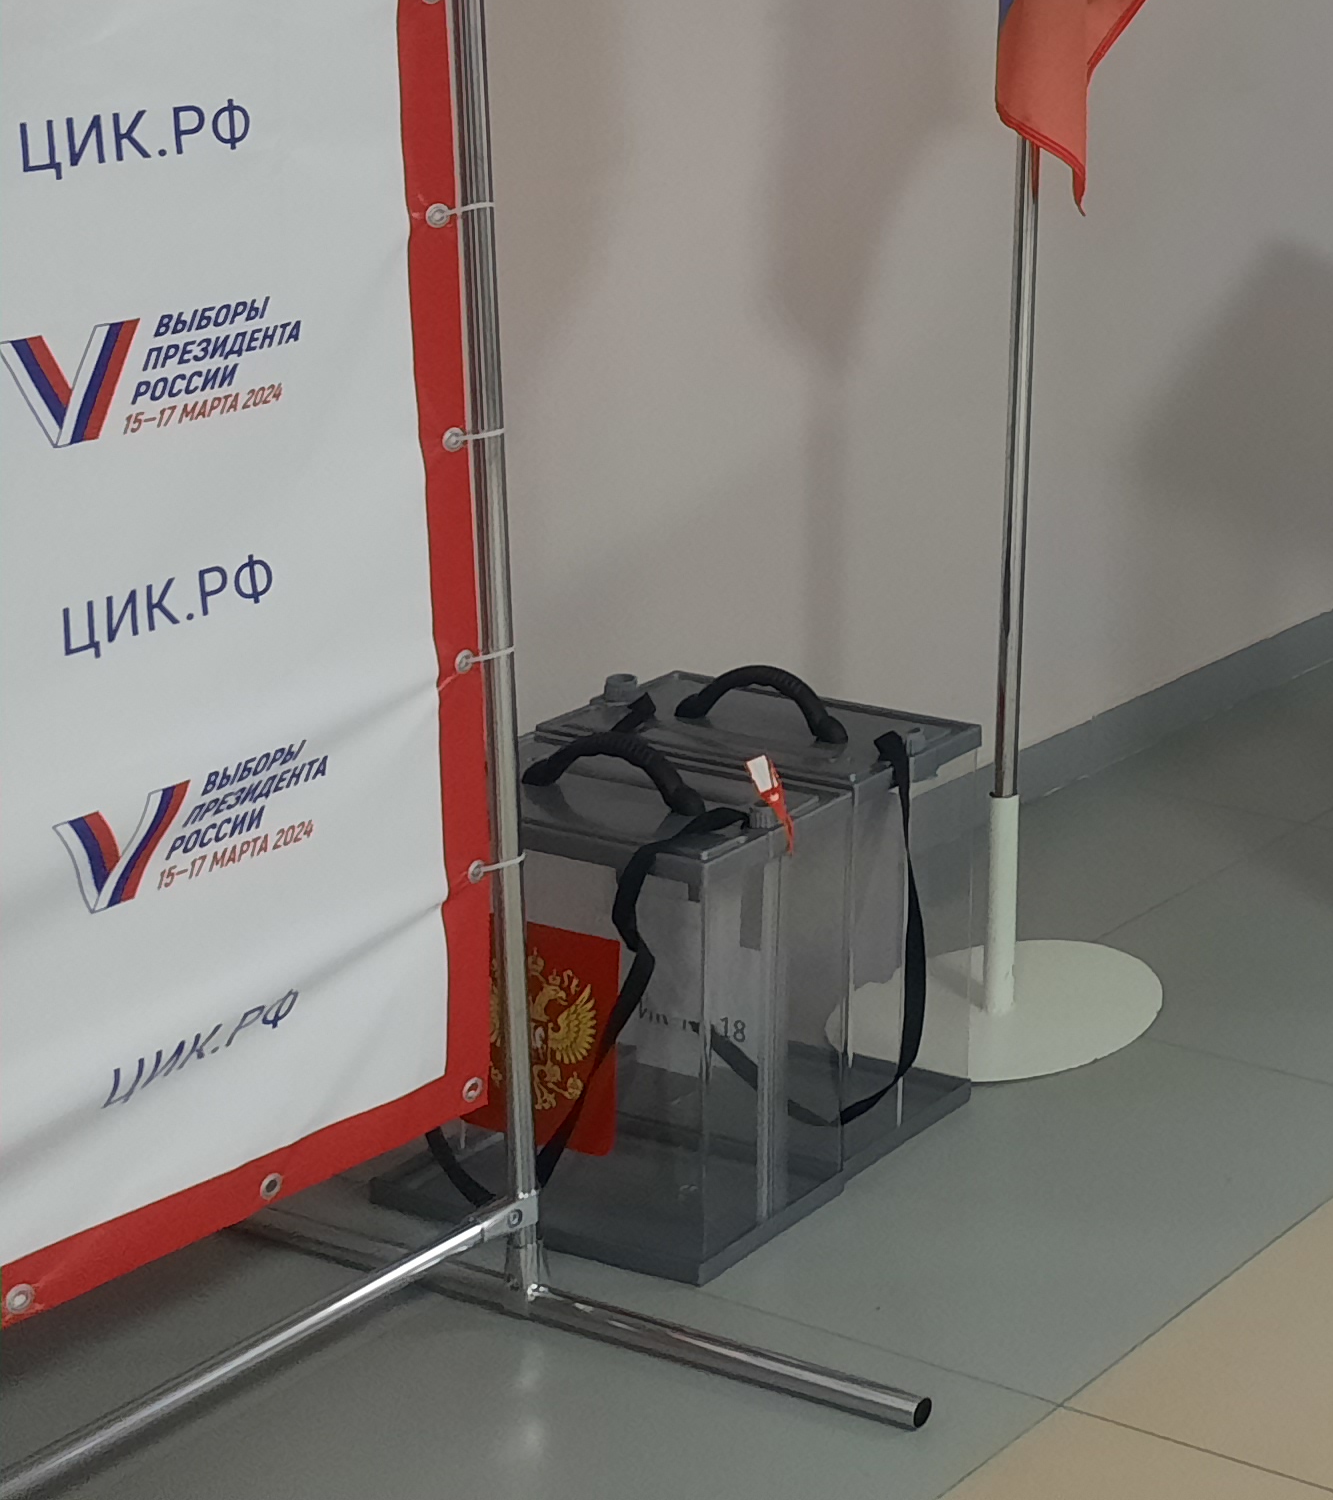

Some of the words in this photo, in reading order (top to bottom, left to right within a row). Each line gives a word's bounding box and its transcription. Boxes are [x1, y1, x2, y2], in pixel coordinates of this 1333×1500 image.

[19, 98, 251, 181] ЦИК.РФ
[153, 296, 270, 338] ВЫБОРЫ
[142, 320, 301, 372] ПРЕЗИДЕНТА
[130, 363, 239, 405] РОССИИ
[177, 393, 240, 424] МАРТА
[241, 382, 283, 410] 2024
[62, 553, 273, 659] ЦИК.РФ
[182, 755, 329, 828] ПРЕЗИДЕНТА
[201, 739, 307, 797] ВЫБОРЫ
[165, 804, 266, 861] РОССИИ
[208, 833, 269, 872] МАРТА
[272, 819, 315, 850] 2024
[101, 988, 299, 1110] ЦИК.РФ
